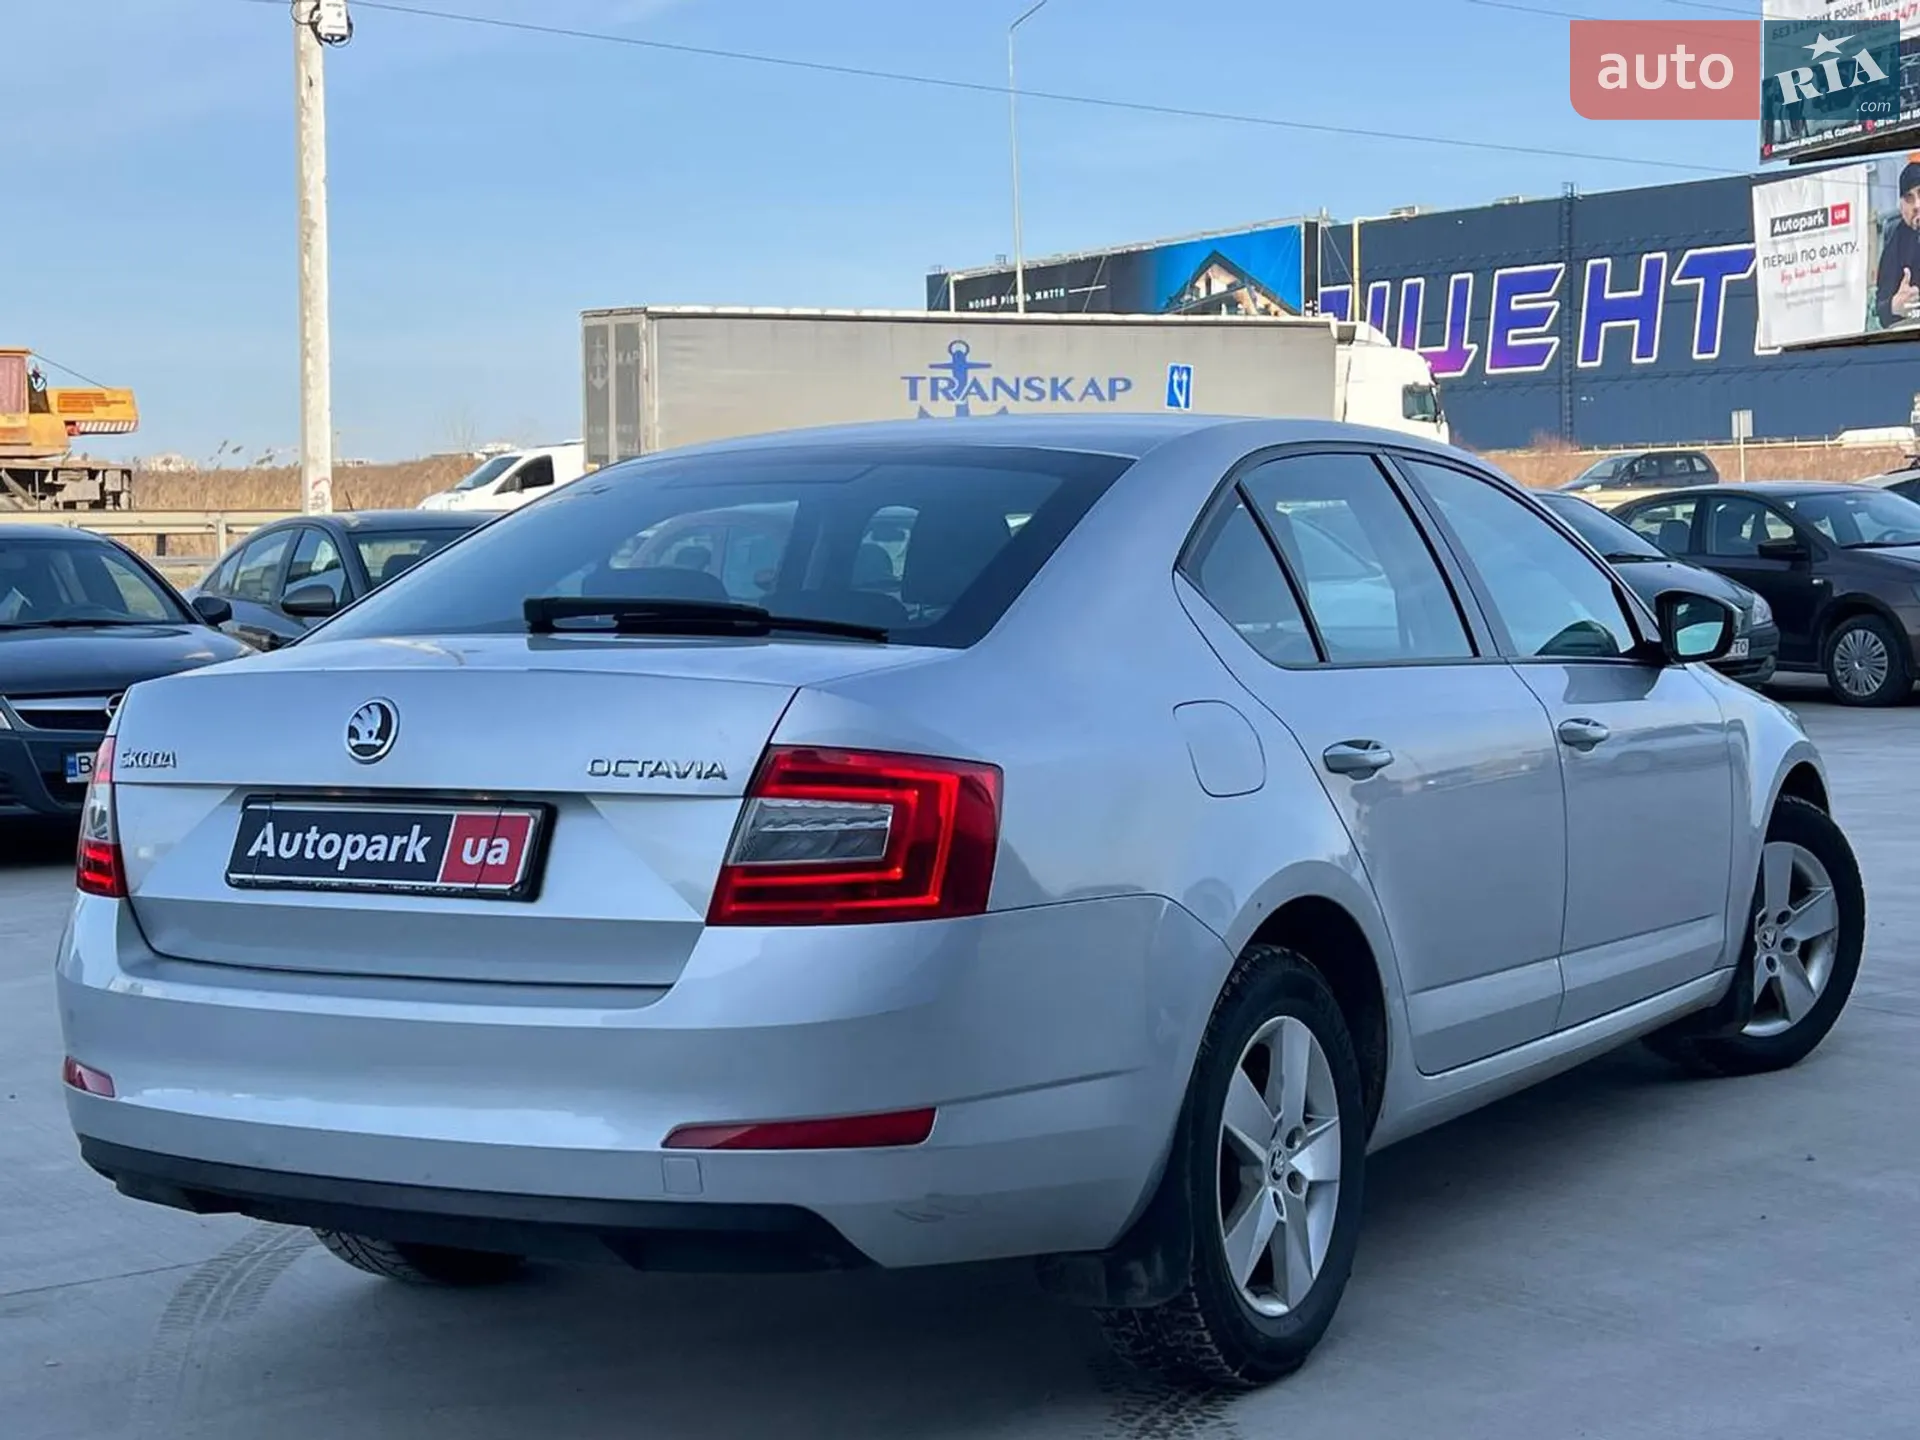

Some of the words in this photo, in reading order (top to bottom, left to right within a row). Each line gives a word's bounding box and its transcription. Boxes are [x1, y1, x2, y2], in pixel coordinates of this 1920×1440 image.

[1773, 210, 1825, 233] Autopark
[1763, 251, 1798, 270] ПЕРШІ
[1801, 247, 1817, 262] ПО
[1819, 241, 1859, 259] ФАКТУ.
[901, 376, 1133, 402] TRANSKAP
[78, 755, 93, 774] B
[587, 758, 728, 780] OCTAVIA
[247, 821, 432, 871] Autopark
[461, 836, 510, 866] ua
